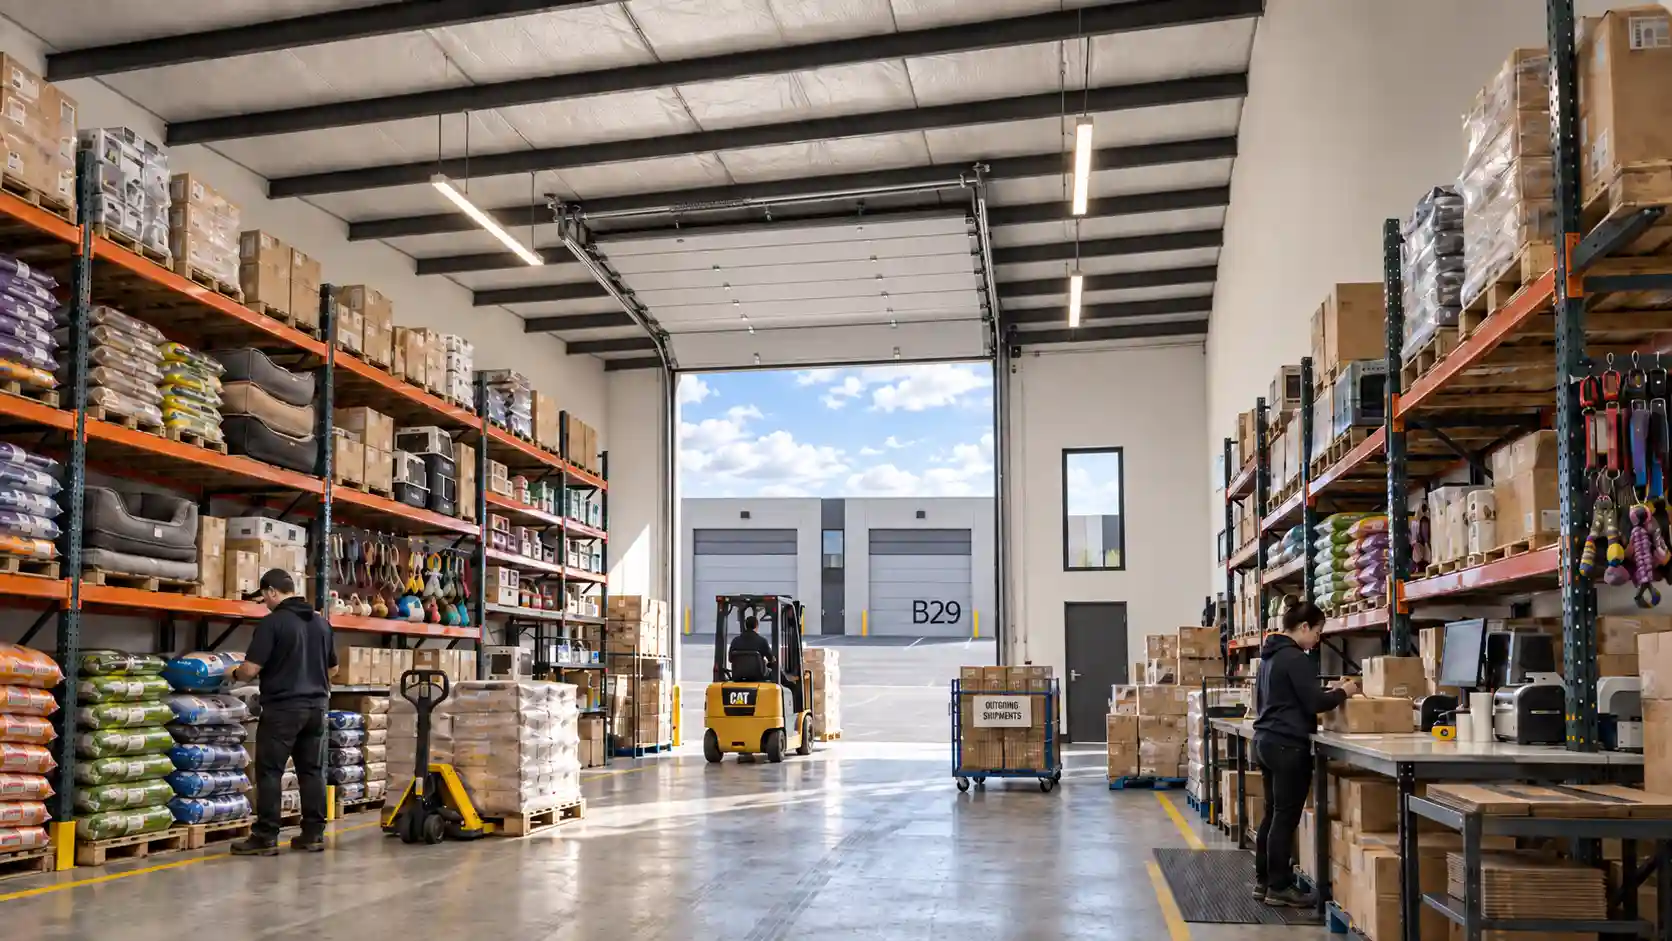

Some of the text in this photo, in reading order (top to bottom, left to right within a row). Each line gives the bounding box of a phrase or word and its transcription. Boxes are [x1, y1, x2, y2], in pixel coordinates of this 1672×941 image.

[912, 600, 961, 624] B29
[730, 692, 750, 705] CAT
[985, 701, 1019, 710] OUTGOING
[983, 712, 1022, 720] SHIPMENTS
